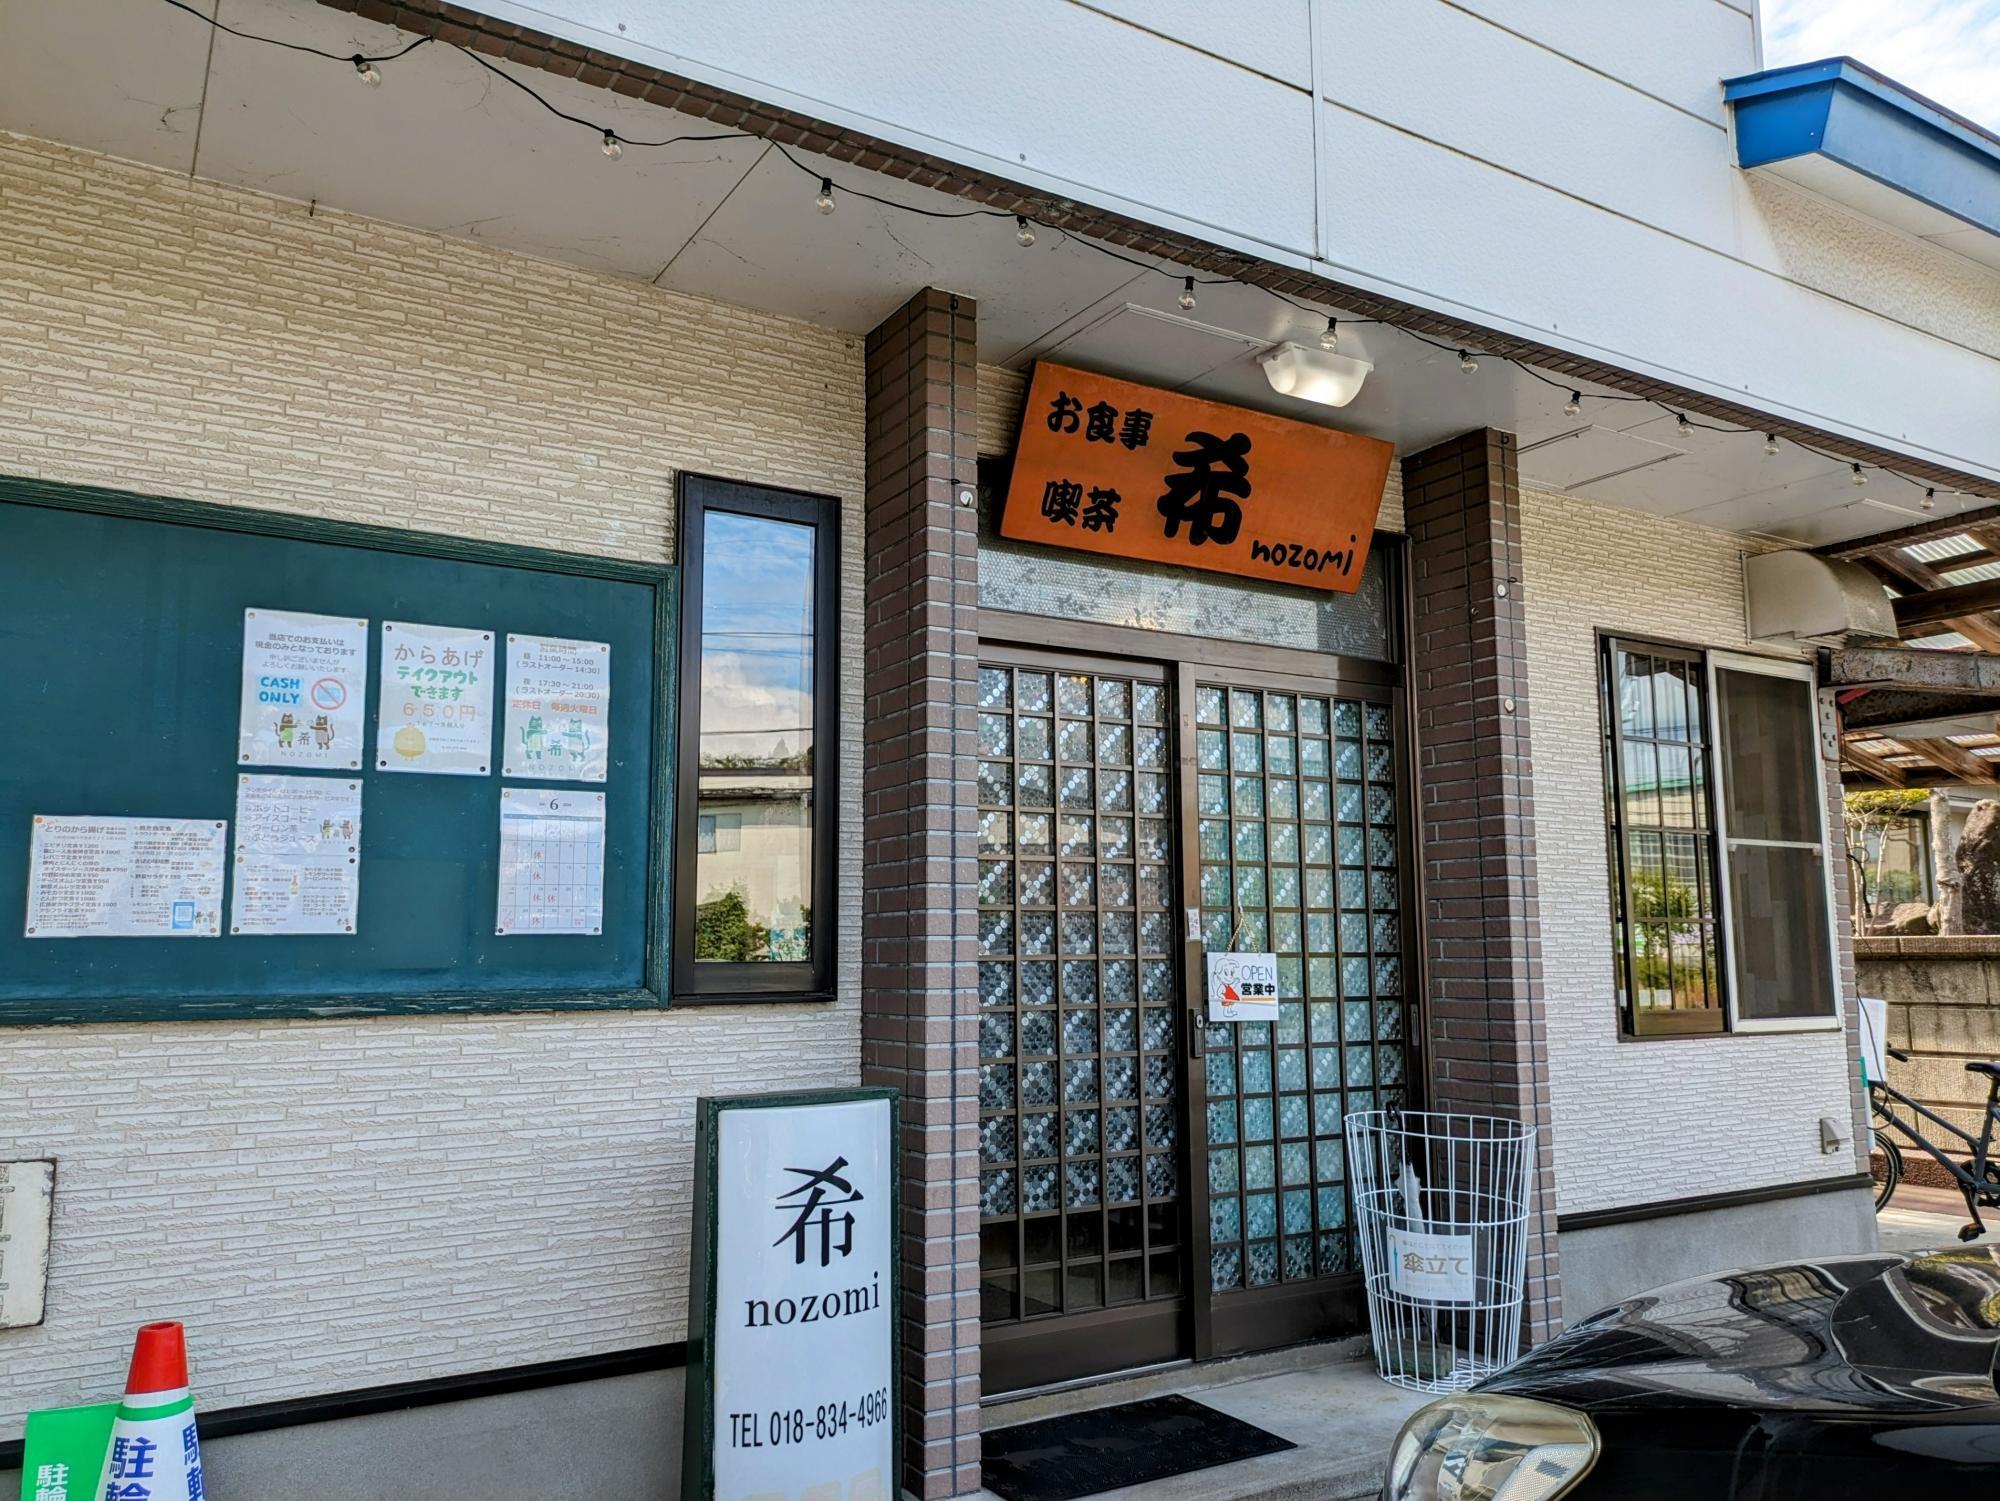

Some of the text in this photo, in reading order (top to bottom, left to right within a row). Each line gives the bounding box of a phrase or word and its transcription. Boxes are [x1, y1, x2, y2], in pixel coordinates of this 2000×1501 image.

[1047, 391, 1154, 450] お食事
[1156, 432, 1252, 546] 希
[1042, 479, 1122, 534] 喫茶
[1251, 534, 1356, 576] nozomi
[256, 640, 356, 656] 現金のみとなっております
[269, 633, 344, 646] 当店でのお支払いは
[394, 644, 484, 668] からあげ
[538, 654, 561, 662] 11:00
[260, 676, 300, 690] CASH
[397, 666, 478, 686] テイクアウト
[259, 692, 300, 704] ONLY
[410, 686, 464, 700] できます
[552, 703, 598, 714] 毎週火曜日
[550, 798, 558, 810] 6
[1242, 965, 1273, 982] OPEN
[1241, 983, 1276, 996] 営業中
[772, 1156, 864, 1267] 希
[1403, 1252, 1469, 1275] 傘立て
[744, 1271, 880, 1327] nozomi
[730, 1386, 888, 1448] TEL 018-834-4966
